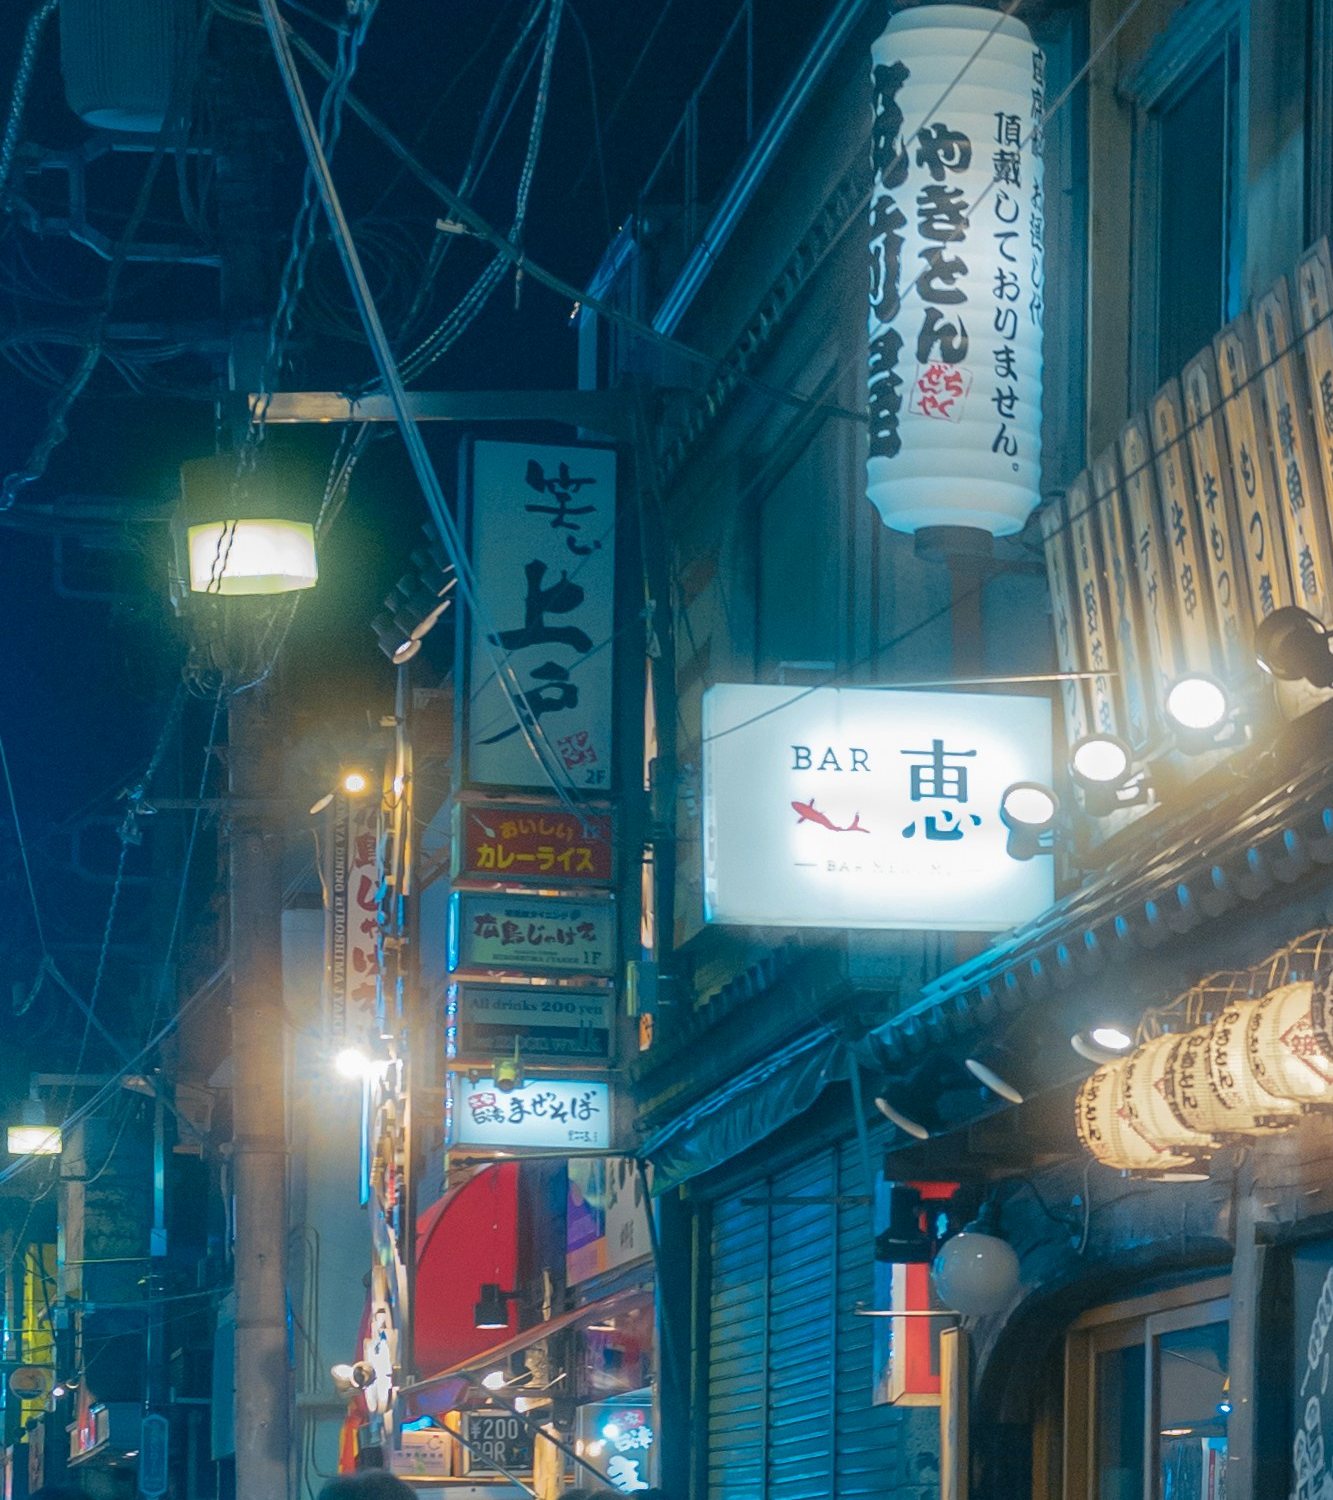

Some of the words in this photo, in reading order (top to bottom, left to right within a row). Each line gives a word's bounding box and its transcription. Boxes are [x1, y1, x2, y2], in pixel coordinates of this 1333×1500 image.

[916, 122, 971, 365] やきとん
[790, 744, 871, 773] BAR
[899, 738, 983, 842] 恵
[499, 816, 576, 842] おいしい
[476, 841, 596, 873] カレーライス
[541, 999, 577, 1014] 200
[510, 1091, 601, 1127] まぜそば
